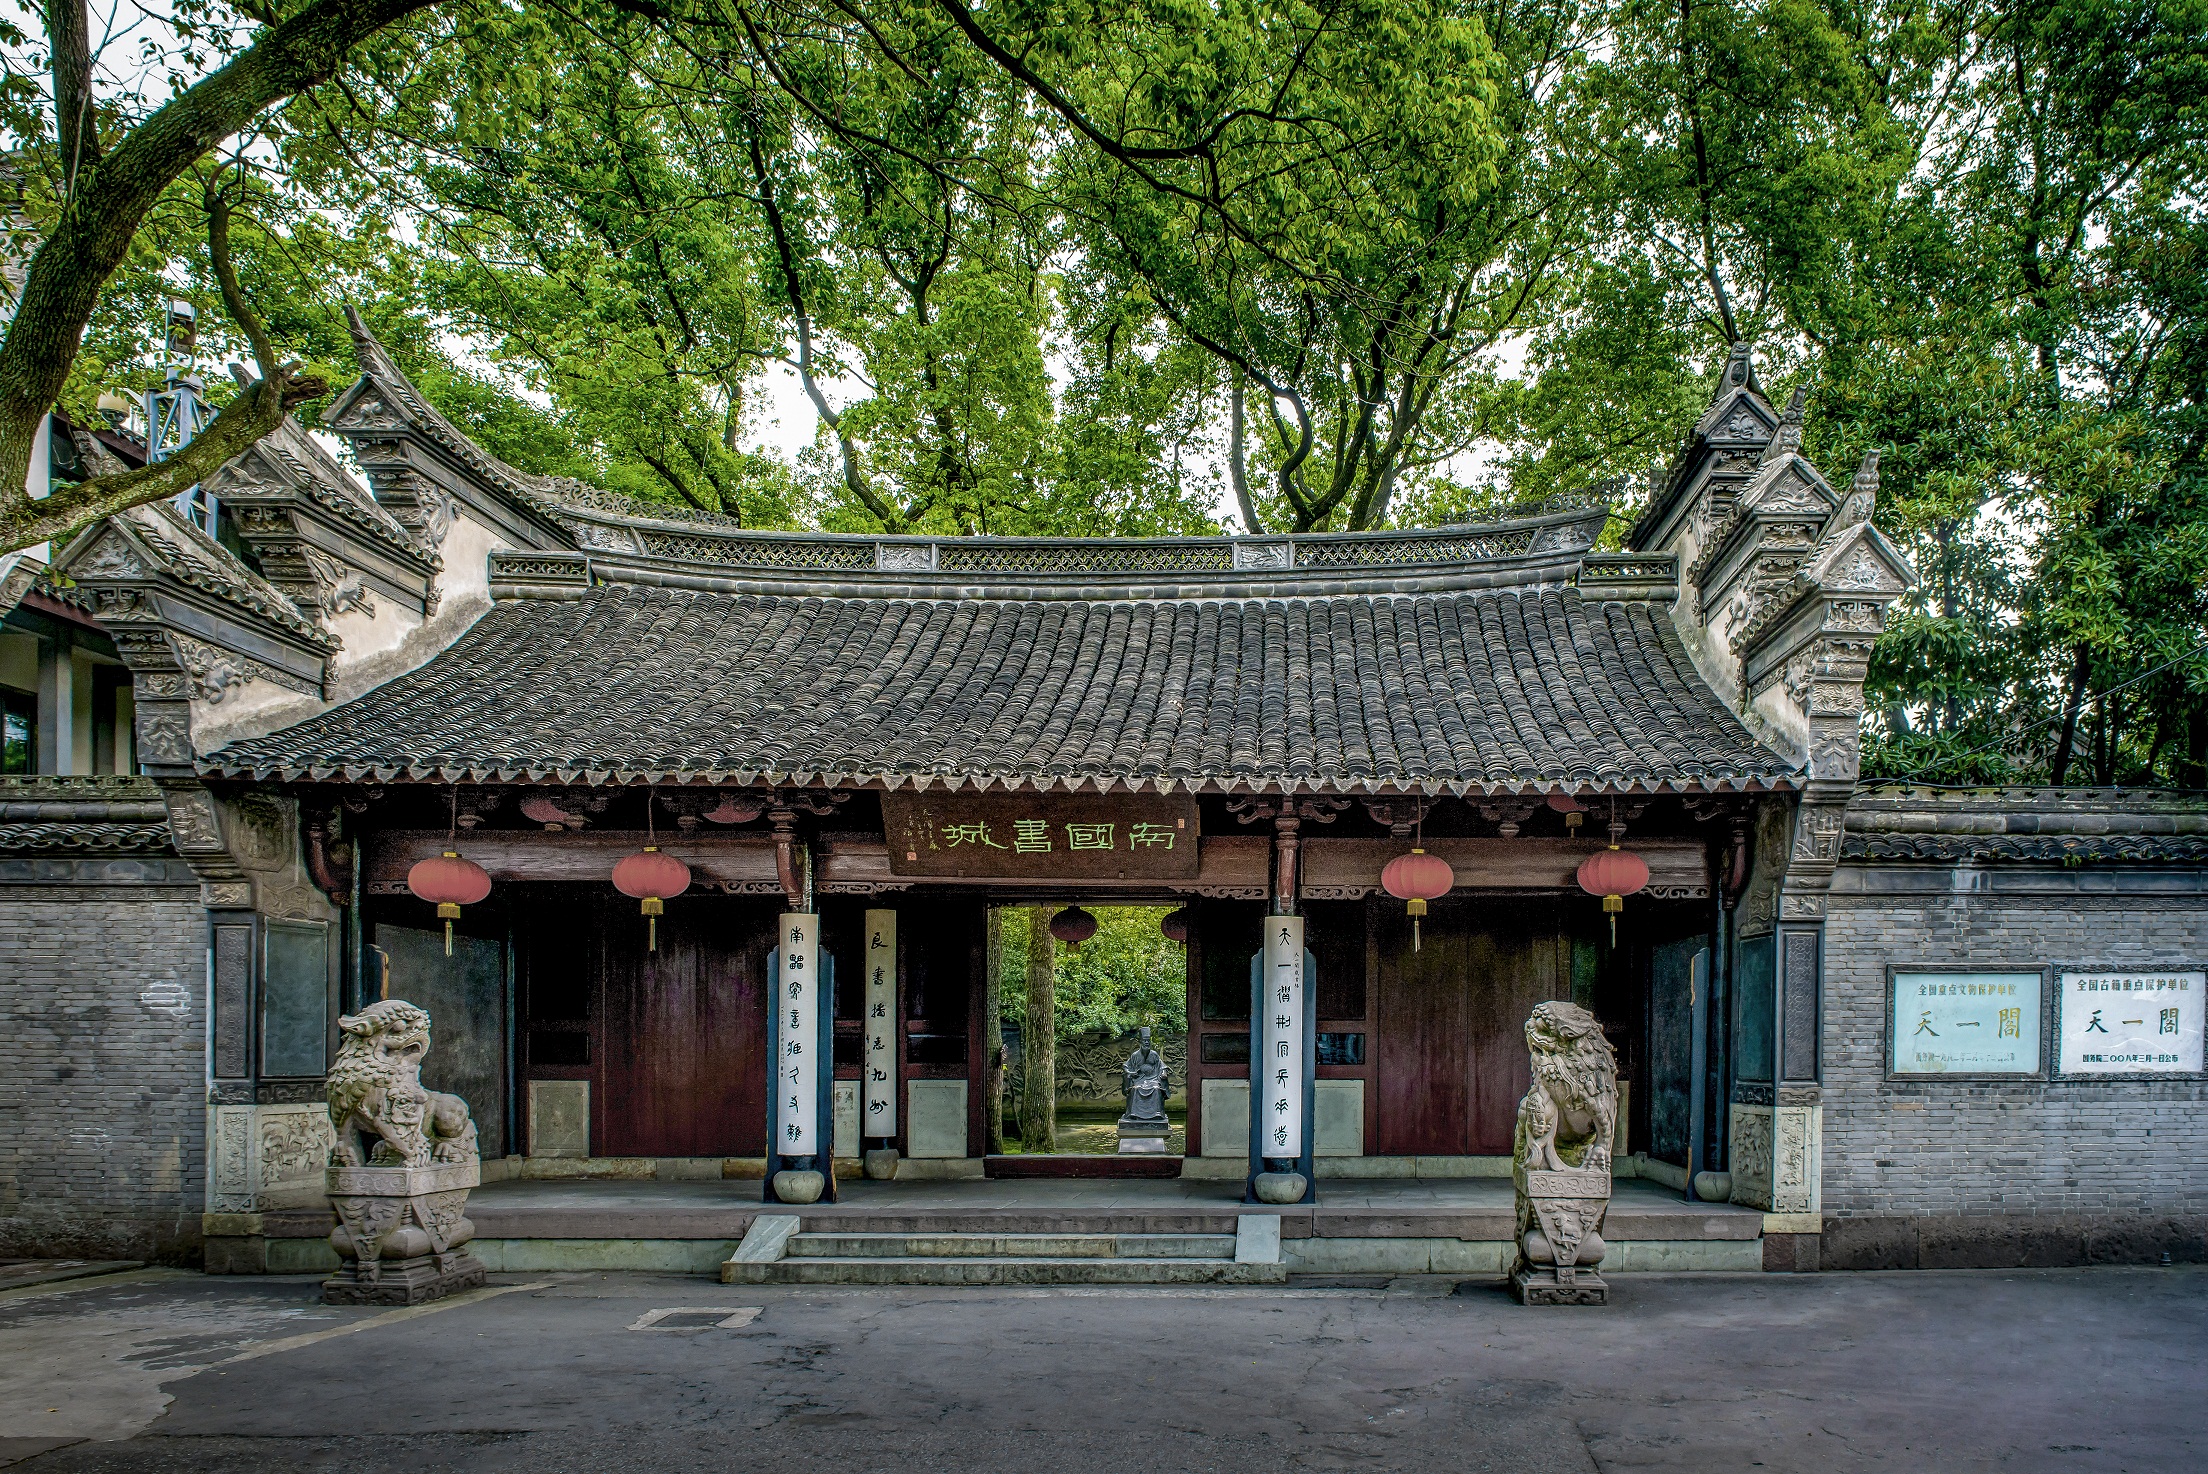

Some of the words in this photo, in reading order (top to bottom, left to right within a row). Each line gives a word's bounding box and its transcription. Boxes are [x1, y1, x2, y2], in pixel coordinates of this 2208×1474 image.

[941, 819, 1175, 853] 南國書城
[1918, 983, 2017, 996] 全国重点文物保护单位
[2077, 978, 2189, 991] 全国古籍重点保护单位
[1913, 1007, 2021, 1039] 天一閣
[2085, 1007, 2179, 1036] 天一閣
